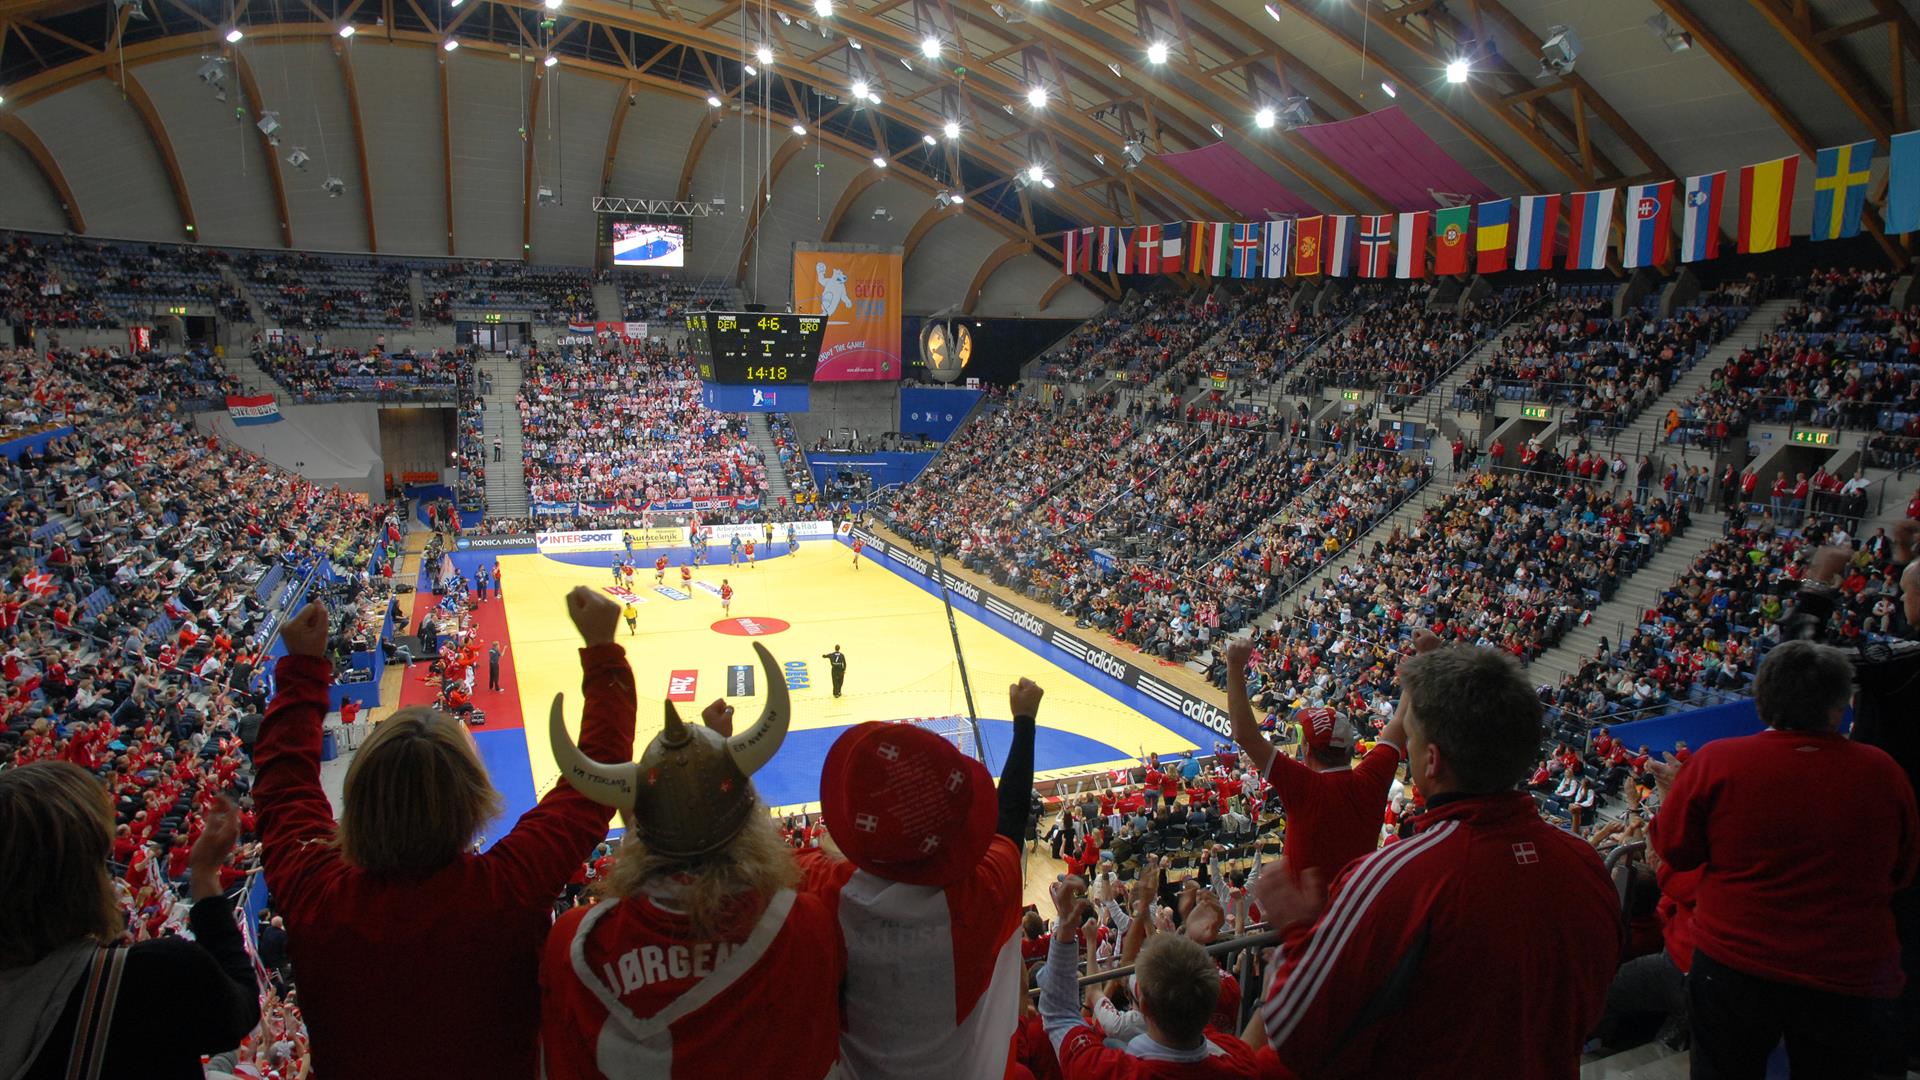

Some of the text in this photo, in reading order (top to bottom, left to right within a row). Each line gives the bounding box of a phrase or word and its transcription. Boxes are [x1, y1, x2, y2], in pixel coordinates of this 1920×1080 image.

[717, 320, 737, 330] DEN
[757, 317, 780, 331] 4:6
[799, 323, 819, 332] CRO
[747, 366, 787, 380] 14:18
[1815, 432, 1829, 444] UT
[471, 535, 536, 547] KONICA MINOLTA
[550, 533, 613, 544] INTERSPORT
[866, 534, 885, 551] adidas
[906, 555, 927, 576] adidas
[953, 580, 978, 601] adidas
[1012, 611, 1043, 637] adidas
[1086, 650, 1126, 681] adidas
[1182, 699, 1232, 737] adidas
